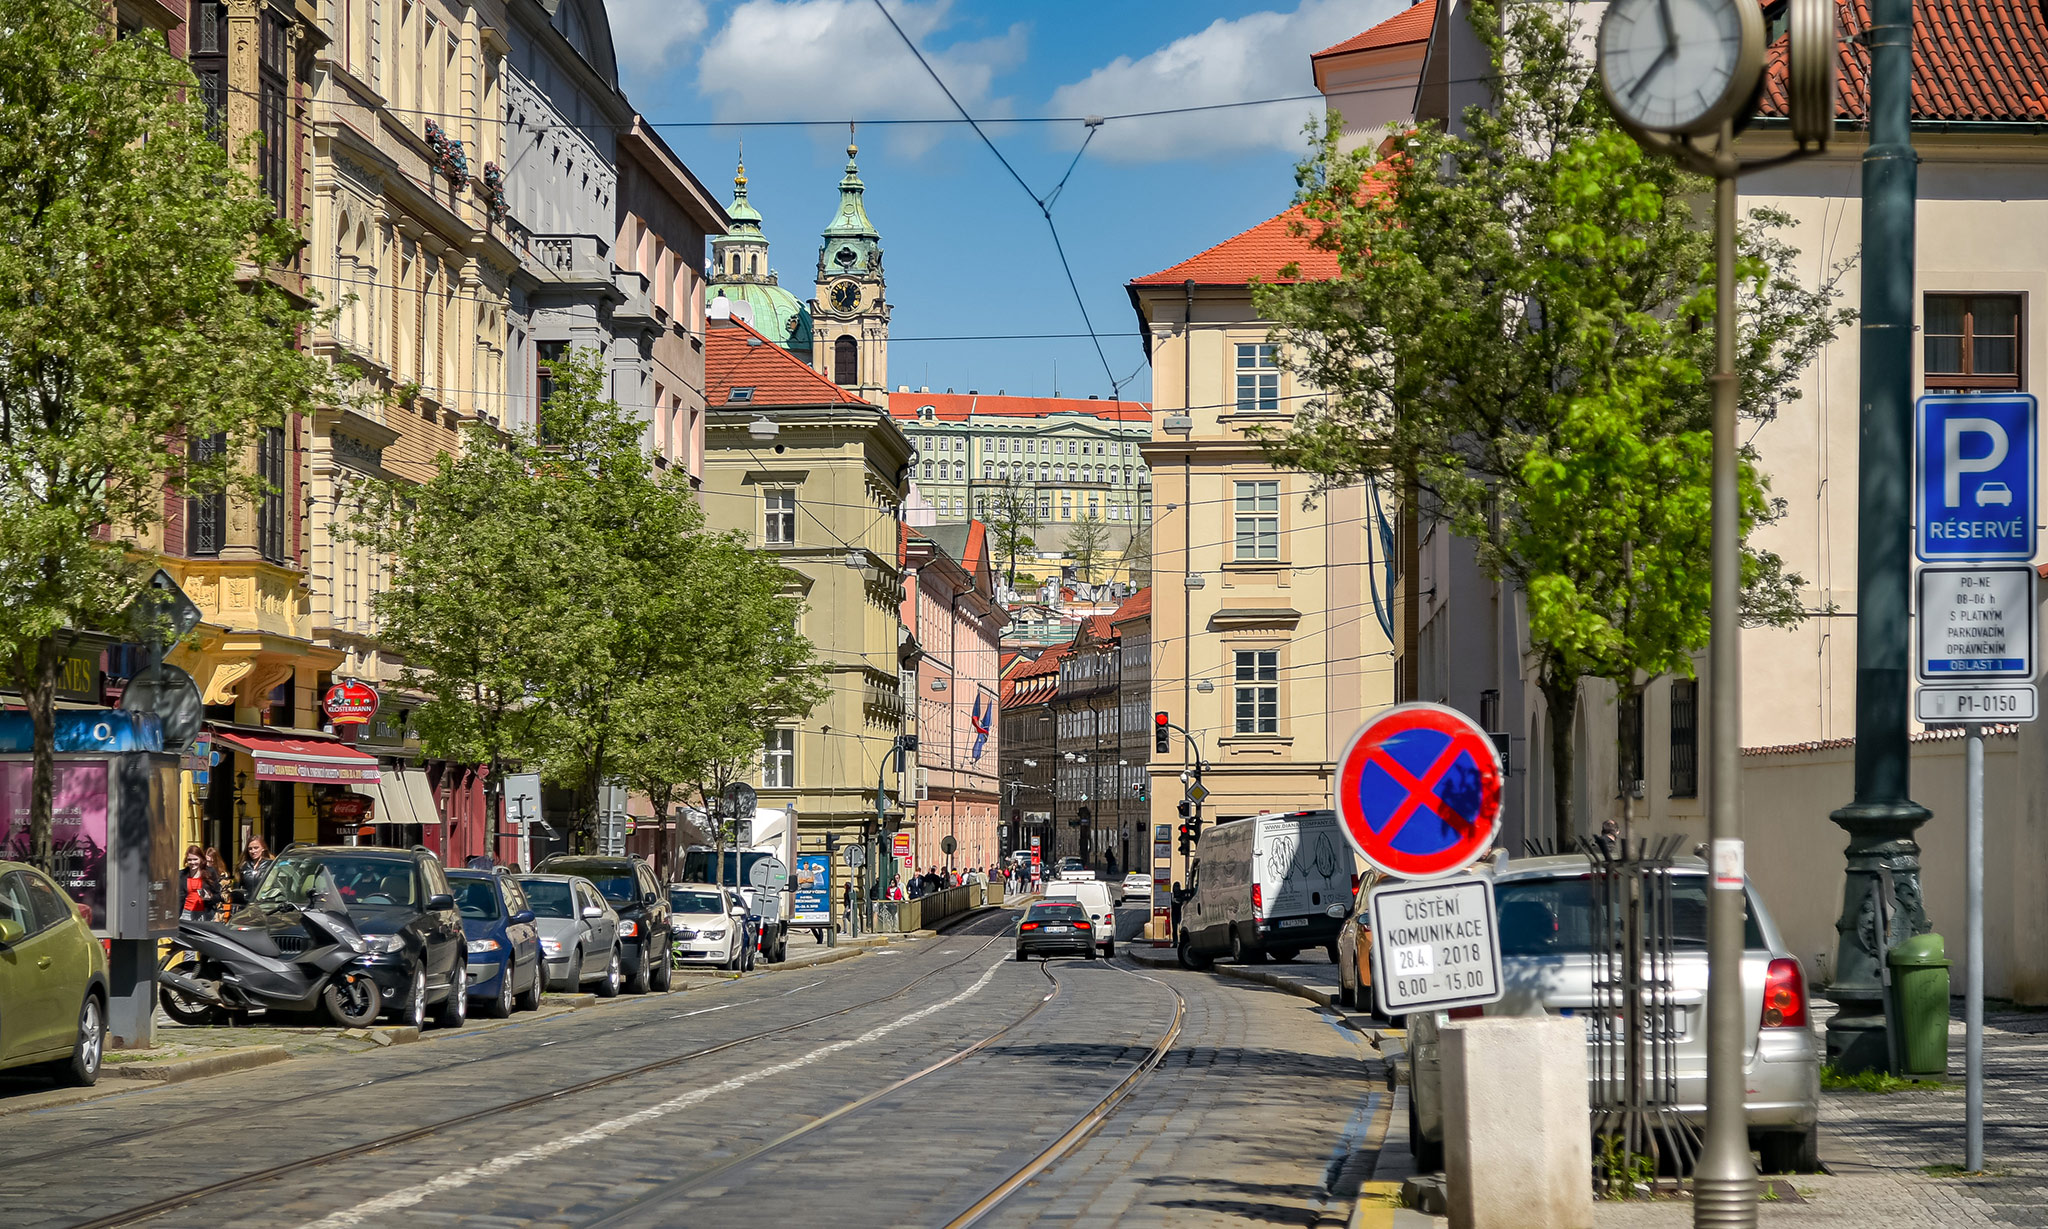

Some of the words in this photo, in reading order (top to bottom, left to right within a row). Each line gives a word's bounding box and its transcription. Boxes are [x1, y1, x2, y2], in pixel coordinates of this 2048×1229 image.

[1945, 418, 2009, 507] P
[1930, 517, 2023, 539] RÉSERVÉ
[1950, 610, 1957, 621] S
[1960, 608, 2003, 621] PLATNÝM
[1948, 624, 2005, 638] PARKOVACÍM
[1946, 641, 2006, 655] OPRÁVNĚNÍM
[1950, 660, 1993, 671] OBLAST
[1998, 660, 2003, 670] 1
[327, 705, 372, 713] KLOSTERMANN
[1958, 695, 2016, 712] P1-0150
[1405, 893, 1460, 920] ČIŠTĚNÍ
[1388, 920, 1483, 947] KOMUNIKACE
